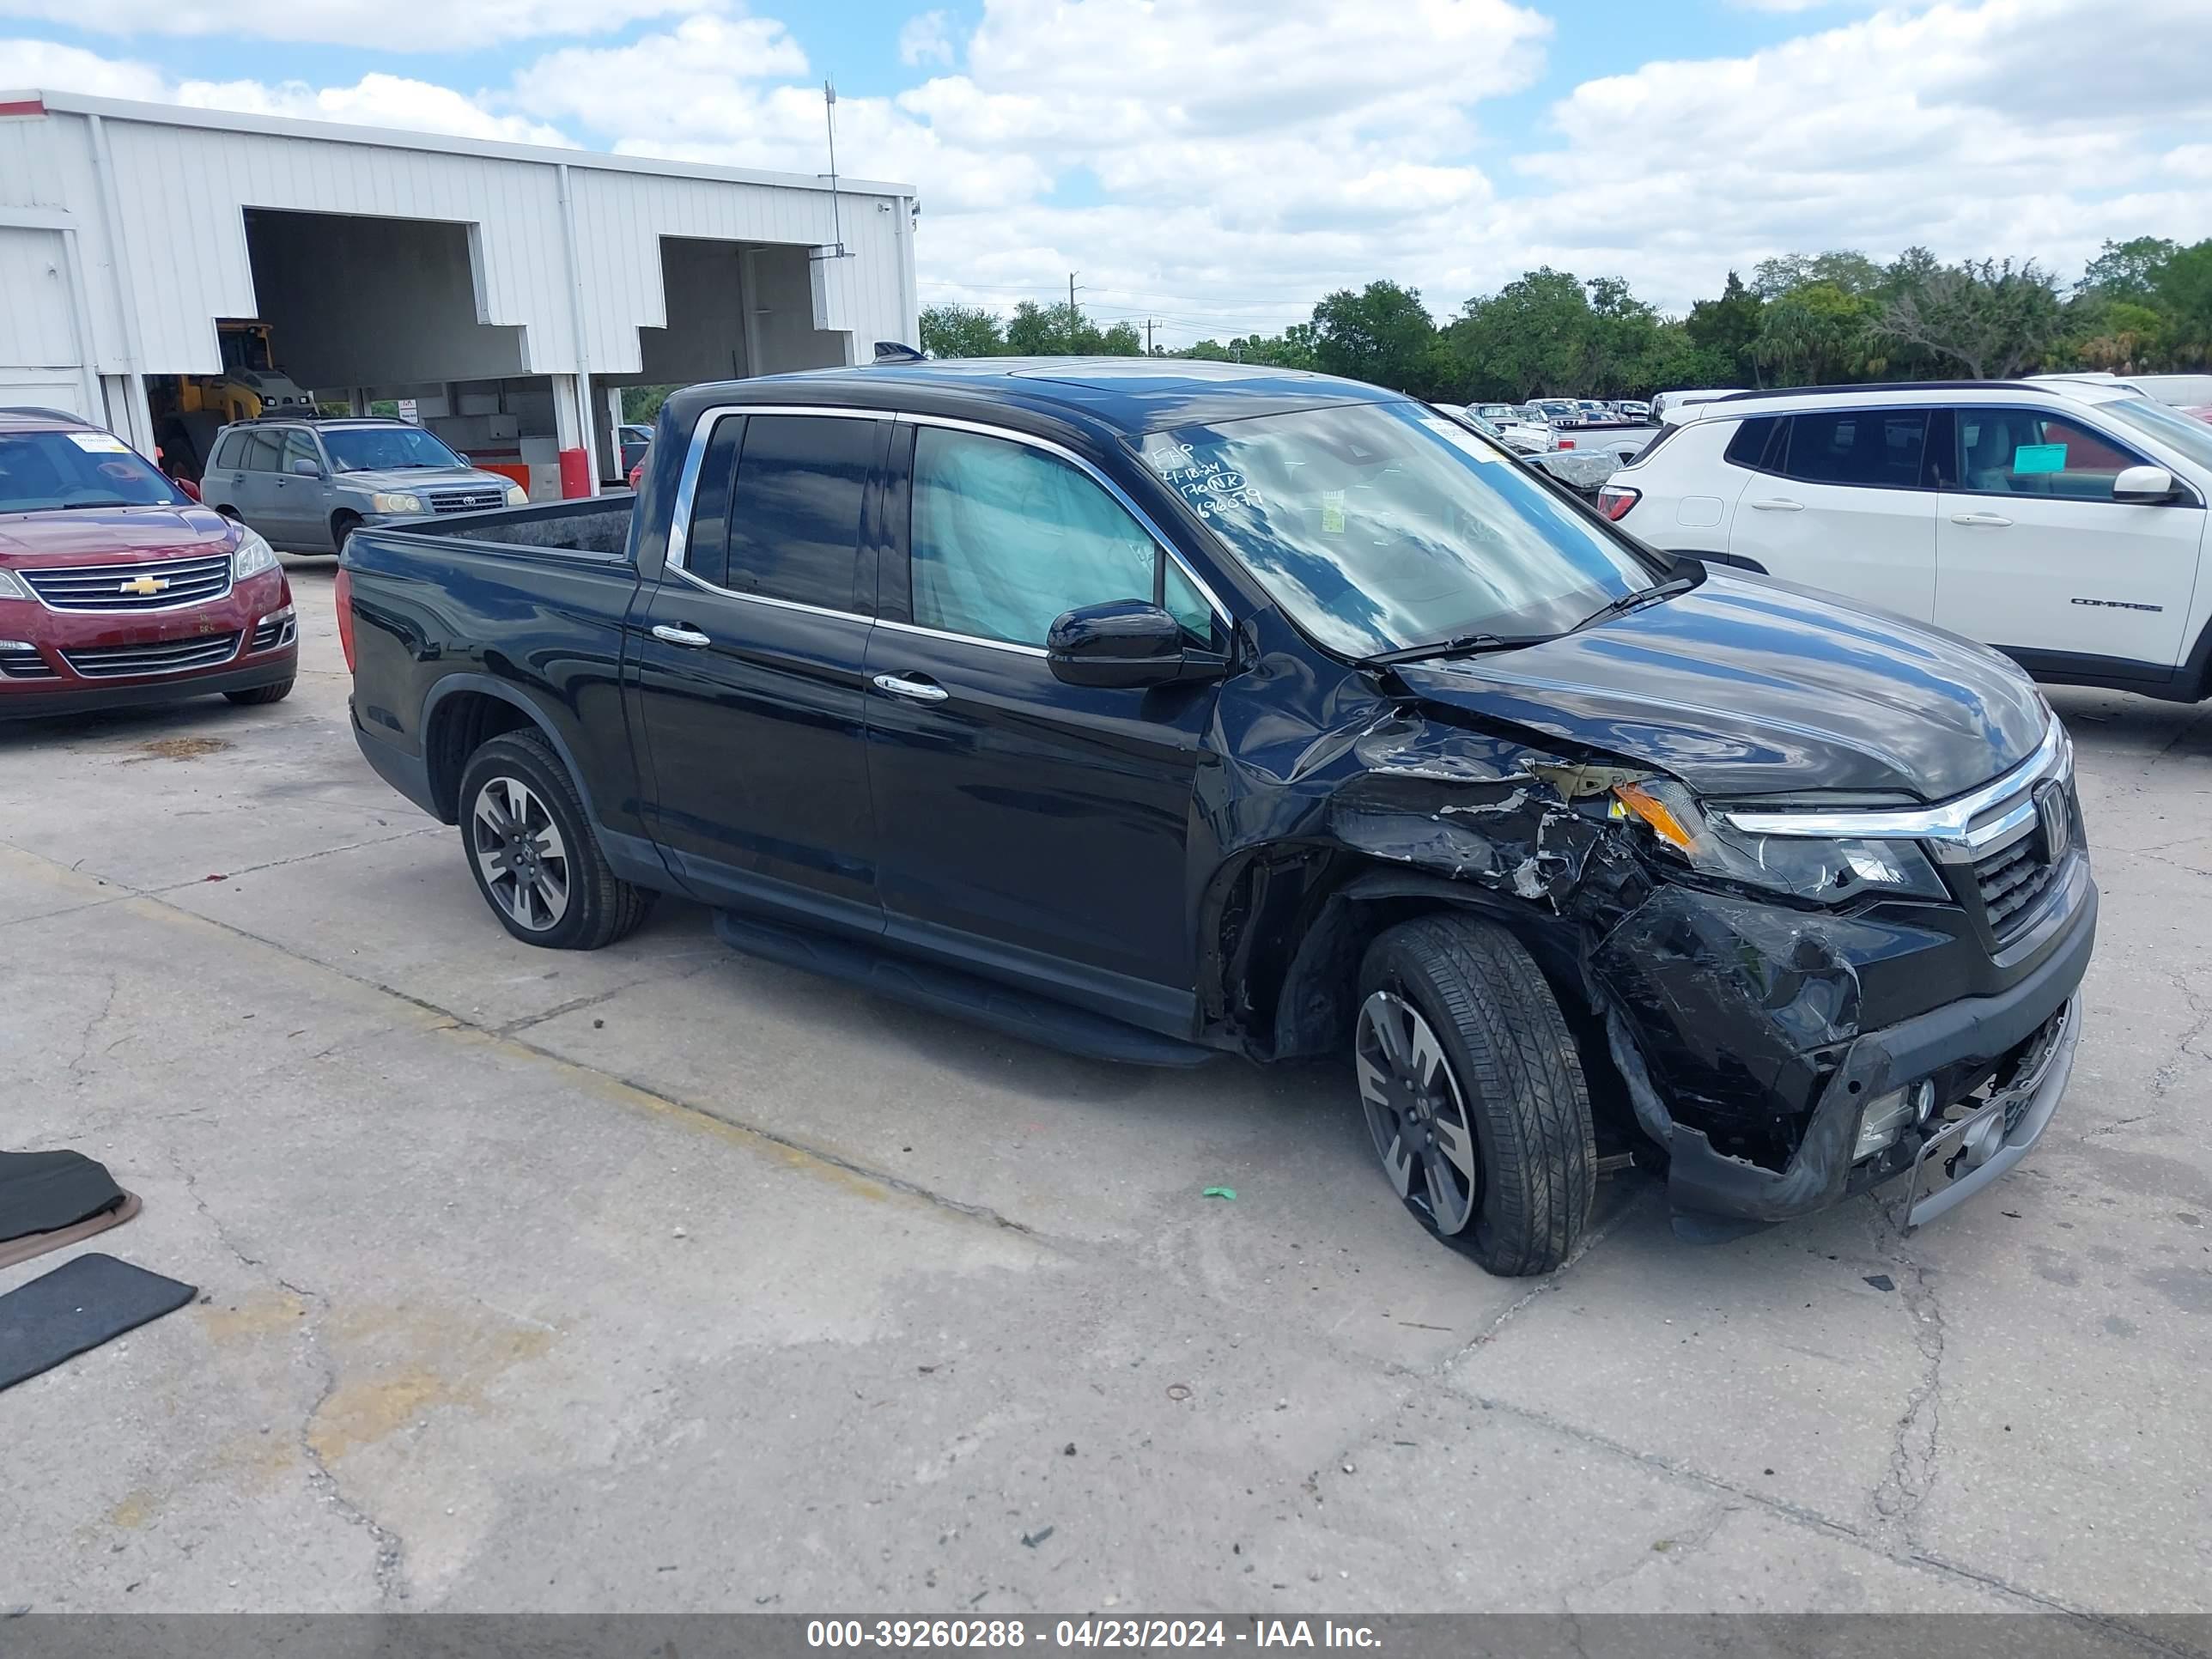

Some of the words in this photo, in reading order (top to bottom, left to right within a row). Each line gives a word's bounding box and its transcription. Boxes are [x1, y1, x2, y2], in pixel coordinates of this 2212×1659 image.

[1164, 462, 1220, 484] 4-18-24
[1197, 488, 1263, 519] 696079
[2070, 598, 2164, 612] COMPASS
